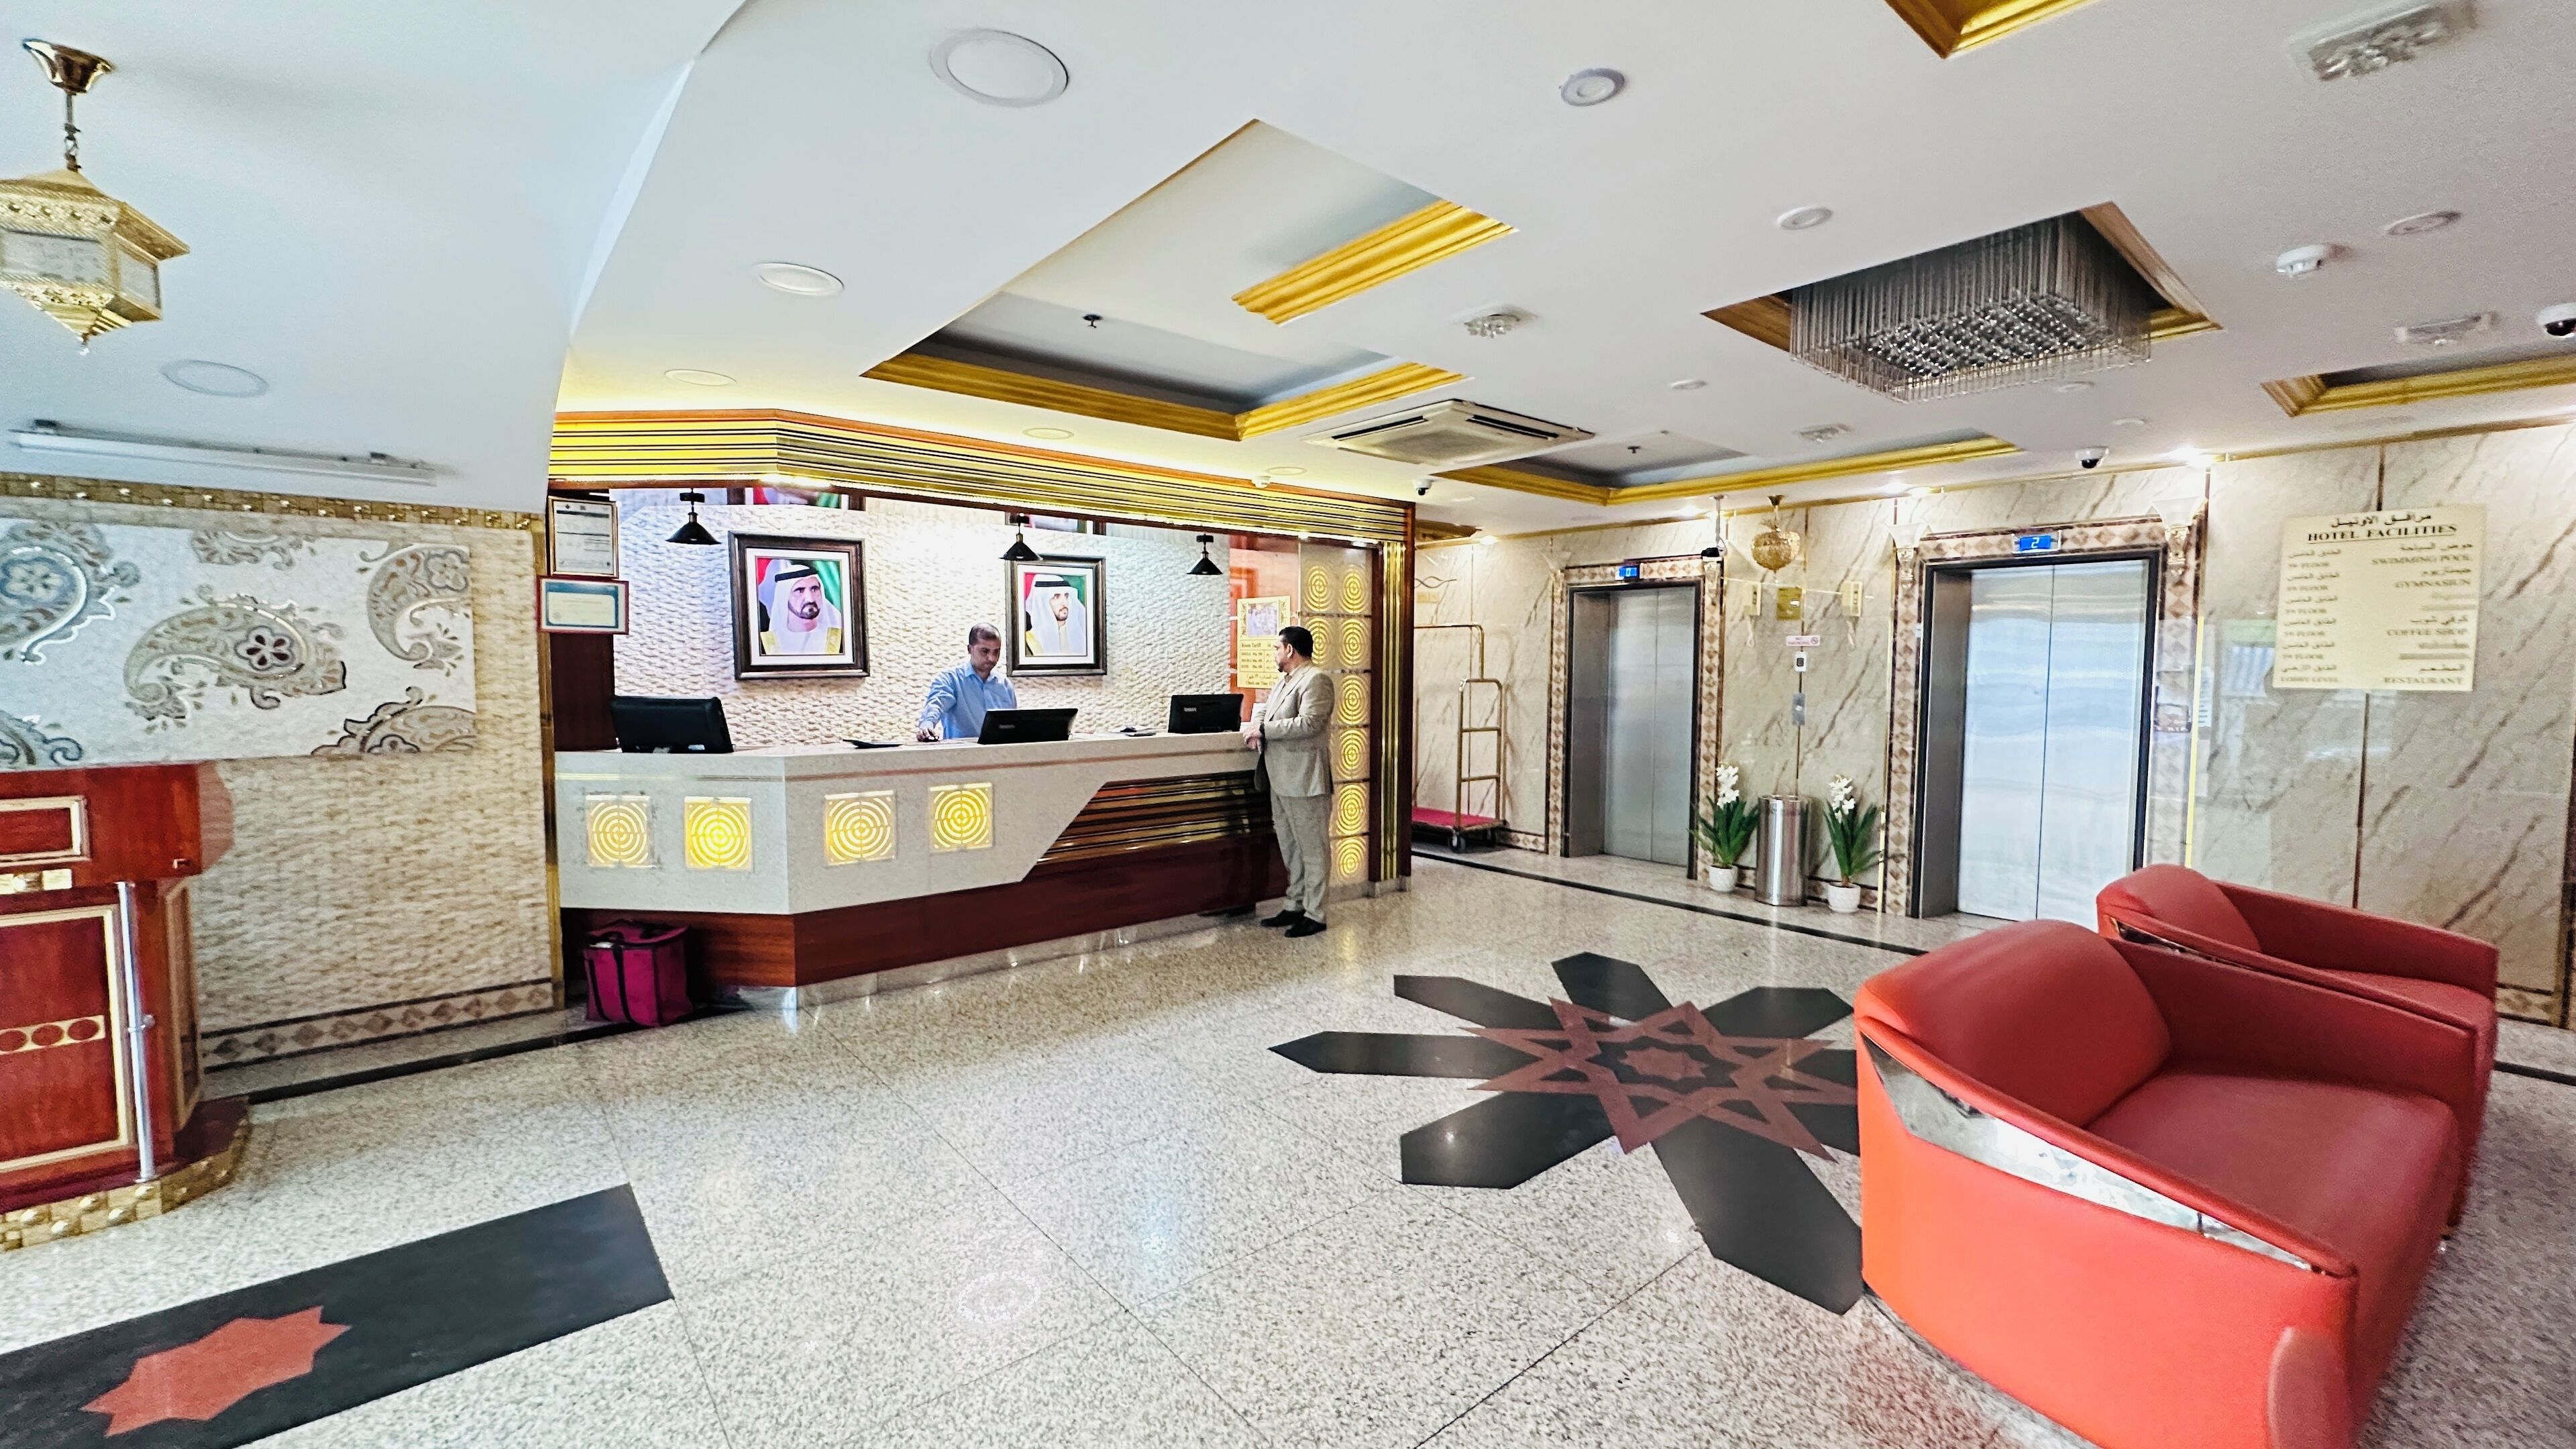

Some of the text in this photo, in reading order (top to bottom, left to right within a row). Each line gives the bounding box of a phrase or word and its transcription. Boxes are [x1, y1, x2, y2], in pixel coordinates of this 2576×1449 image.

[2308, 525, 2457, 541] HOTEL FACILITIES
[2031, 537, 2040, 549] 2
